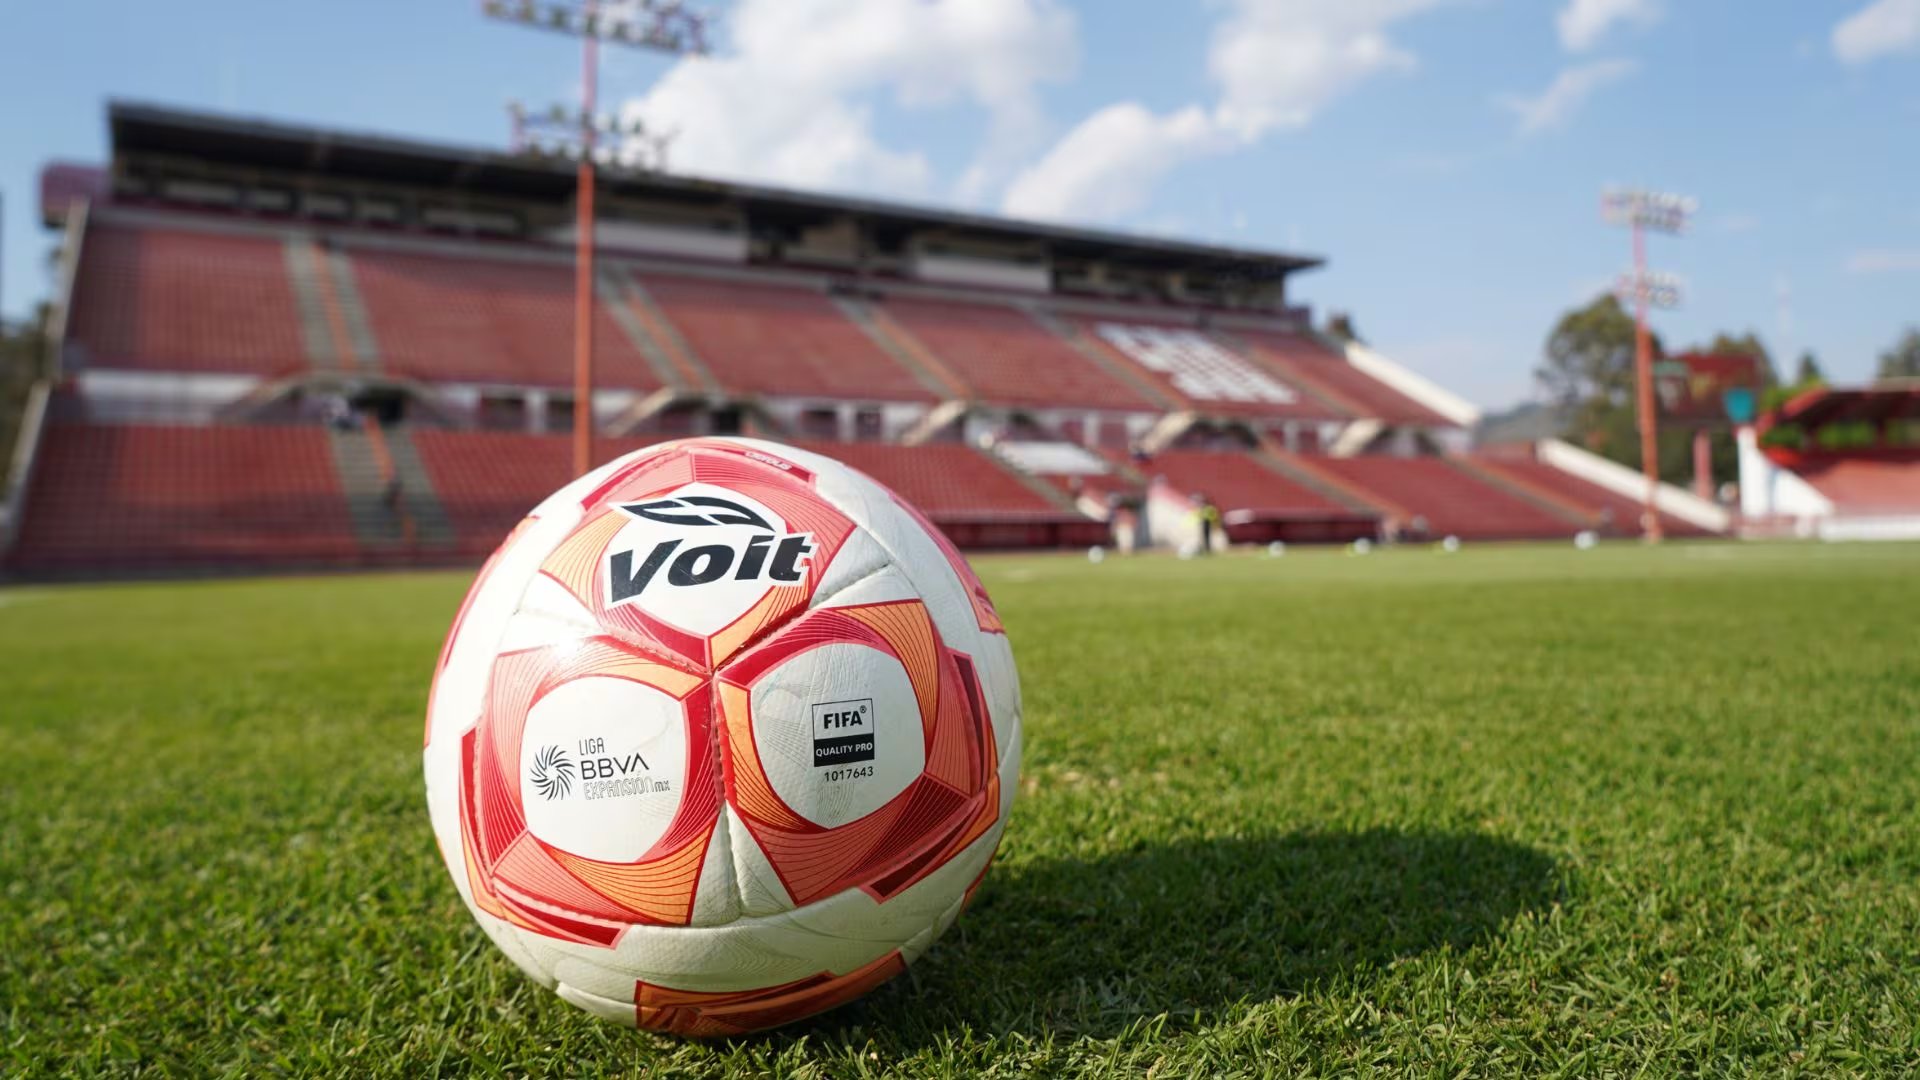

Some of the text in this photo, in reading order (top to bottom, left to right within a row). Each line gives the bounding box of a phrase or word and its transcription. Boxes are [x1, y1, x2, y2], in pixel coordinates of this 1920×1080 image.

[610, 534, 812, 603] Voit
[579, 737, 605, 755] LIGA
[815, 742, 873, 757] QUALITY PRO
[581, 752, 650, 780] BBVA
[824, 766, 874, 782] 1017643
